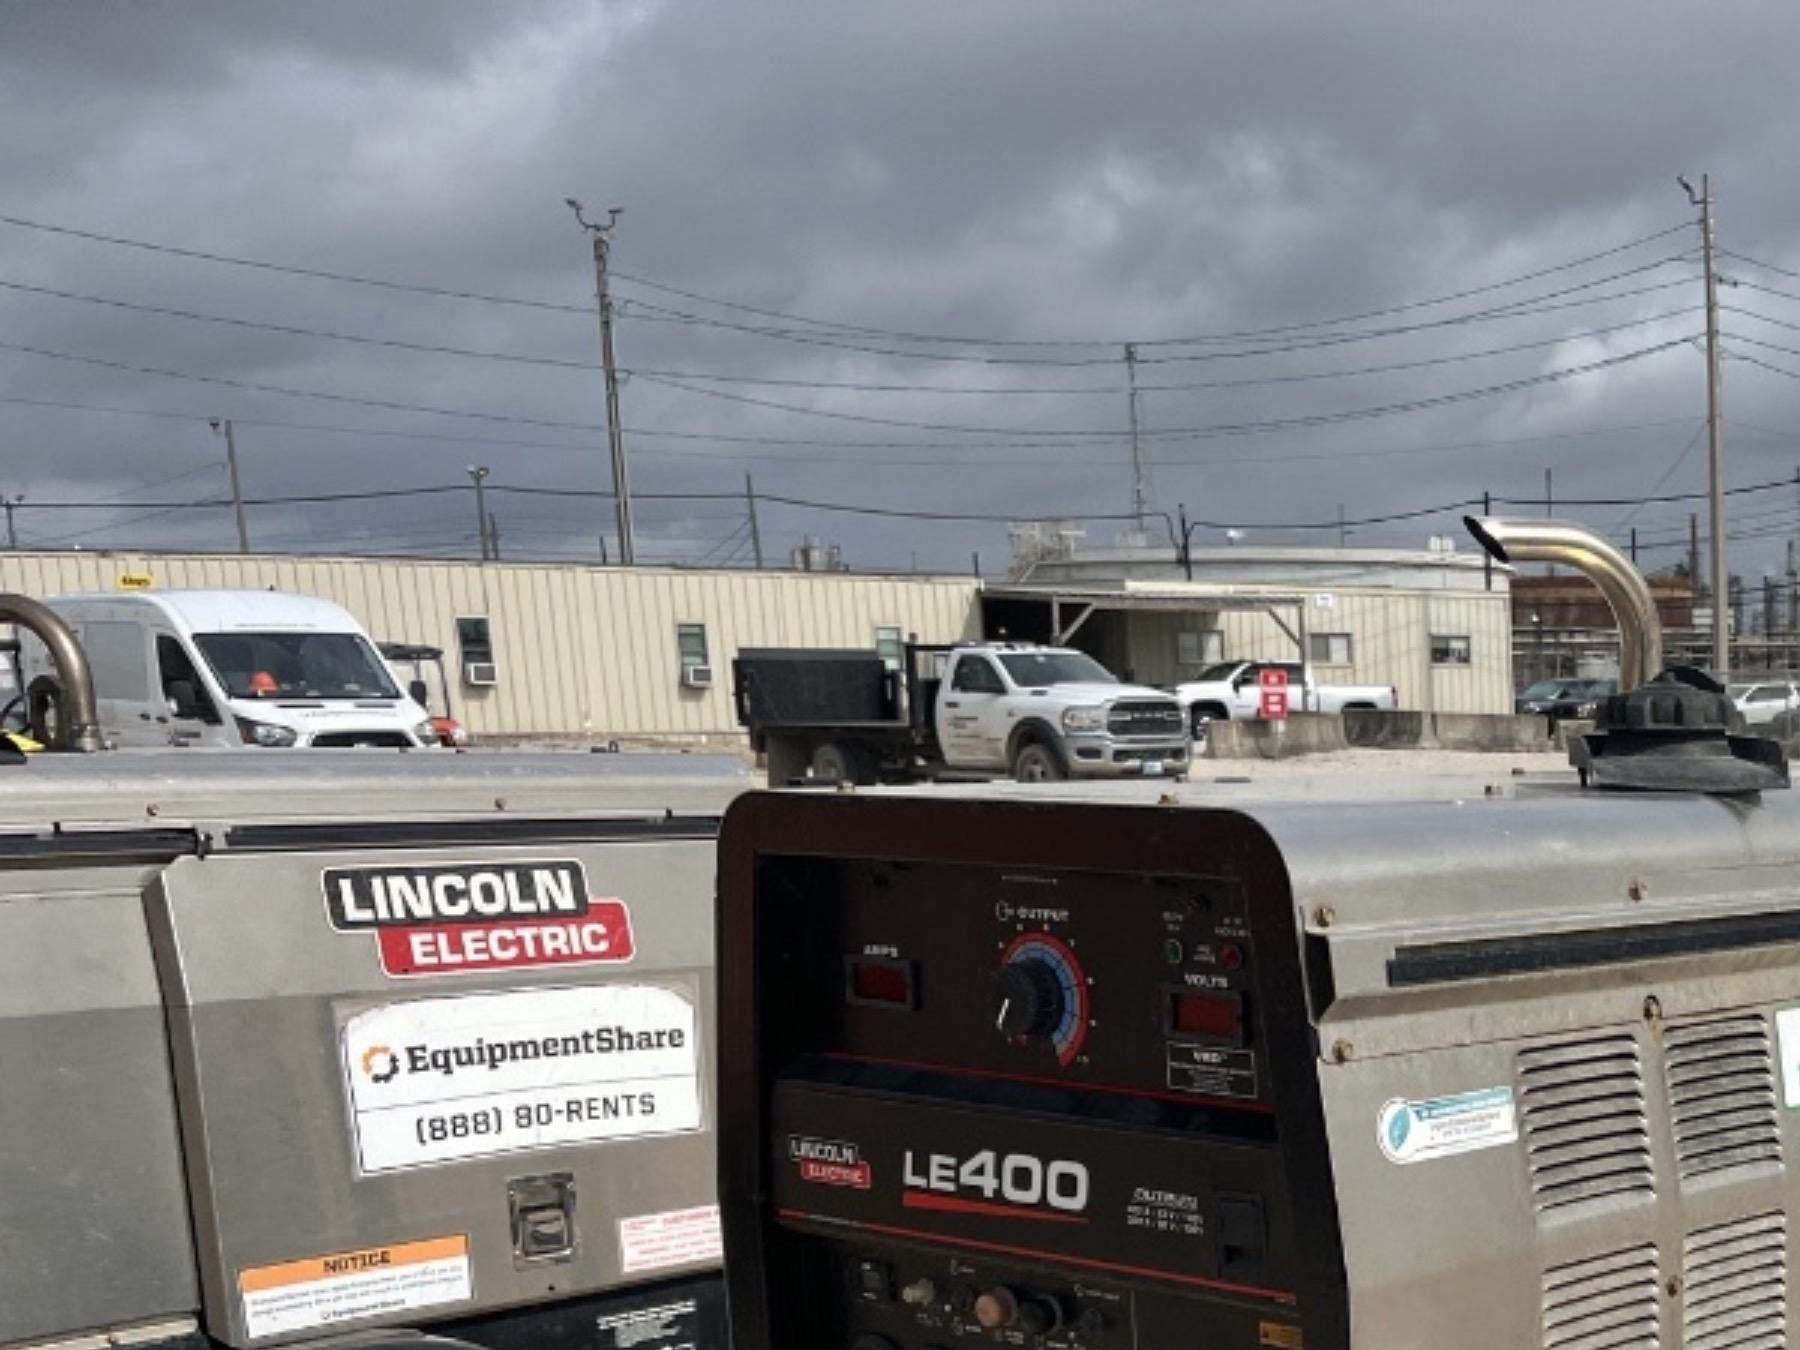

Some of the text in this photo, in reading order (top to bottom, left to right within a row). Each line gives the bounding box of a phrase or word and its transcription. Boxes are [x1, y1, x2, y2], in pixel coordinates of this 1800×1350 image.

[338, 869, 576, 922] LINCOLN
[409, 923, 610, 966] ELECTRIC
[406, 1025, 686, 1076] EquipmentShare
[416, 1092, 656, 1146] (888) 80-RENTS
[904, 1149, 1089, 1211] LE400
[323, 1251, 391, 1273] NOTICE
